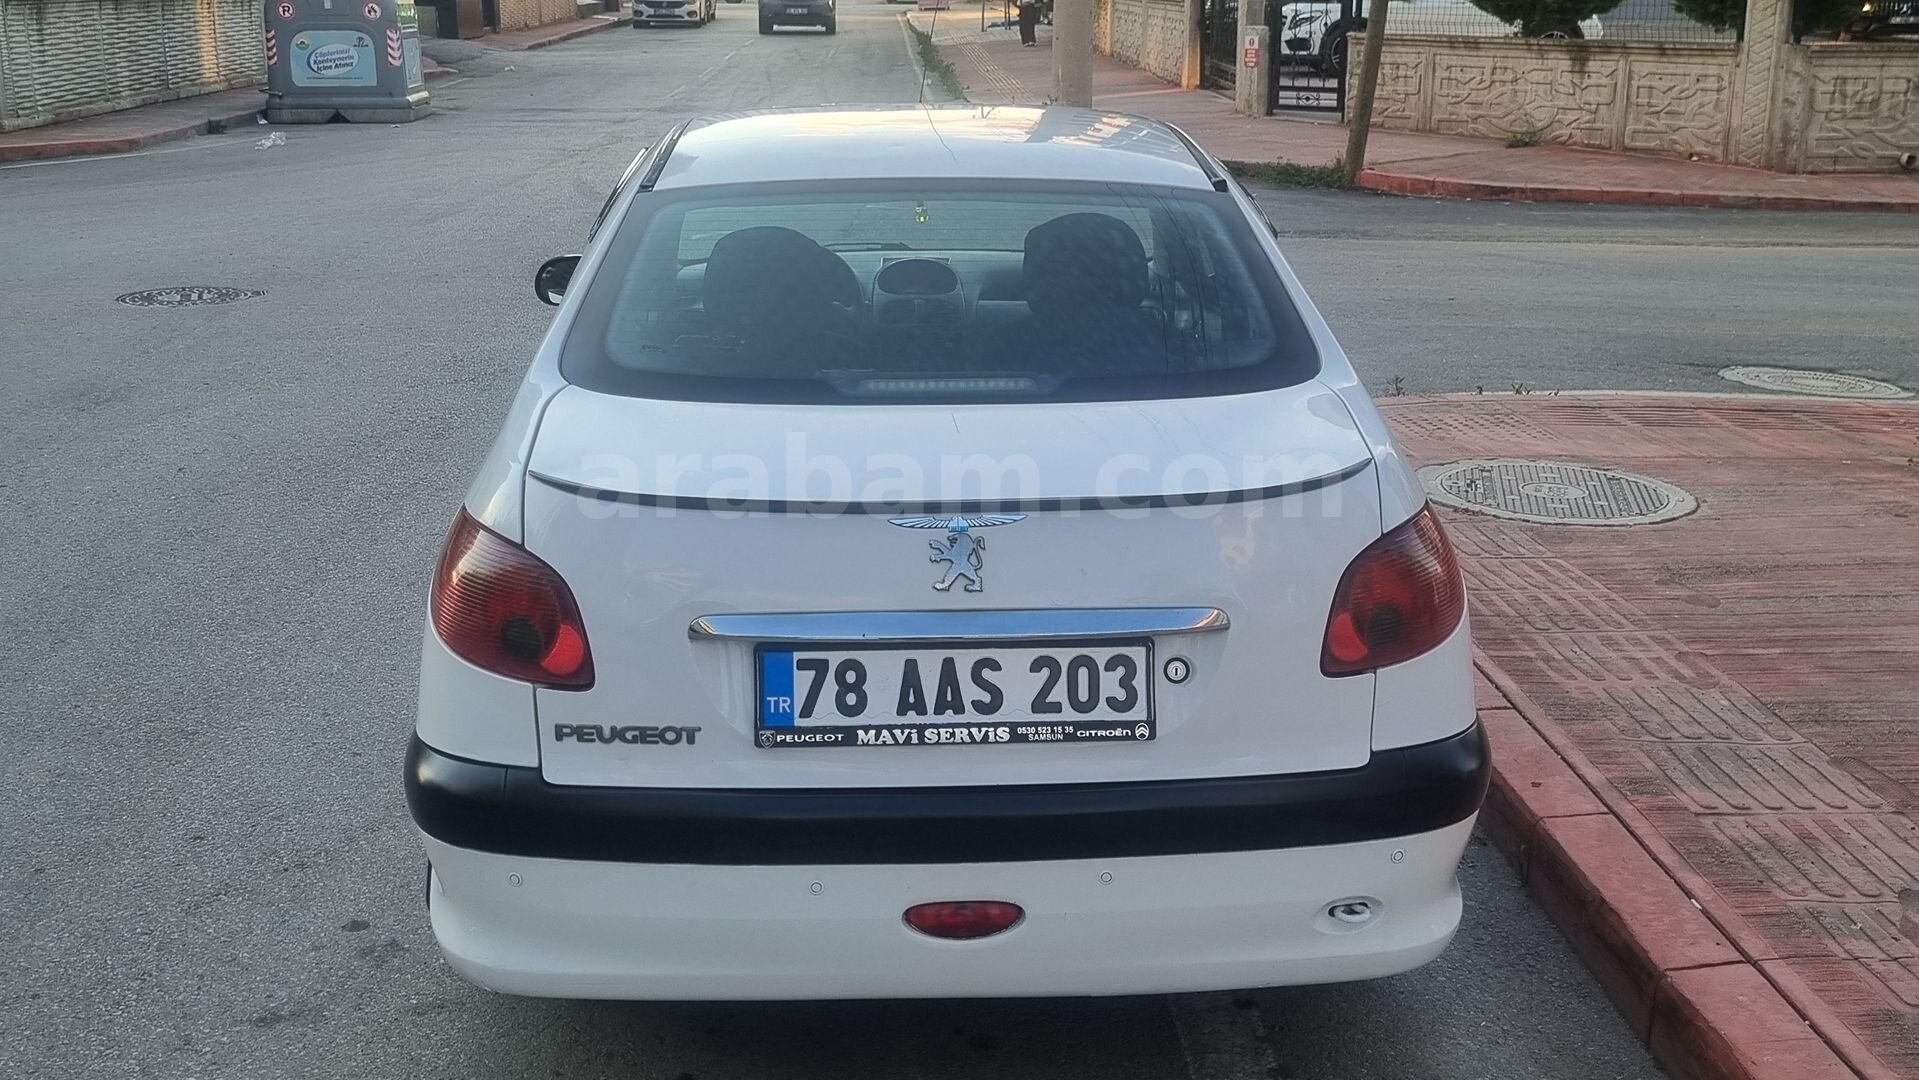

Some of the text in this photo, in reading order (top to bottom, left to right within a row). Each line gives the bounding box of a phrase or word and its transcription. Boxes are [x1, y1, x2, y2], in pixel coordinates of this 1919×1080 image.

[796, 654, 1139, 718] 78 AAS 203
[766, 696, 791, 714] TR
[554, 723, 702, 746] PEUGEOT
[1017, 727, 1036, 735] 0530
[1037, 726, 1051, 734] 523
[1053, 726, 1063, 734] 15
[1028, 733, 1064, 741] SAMSUN
[776, 734, 844, 742] PEUGEOT
